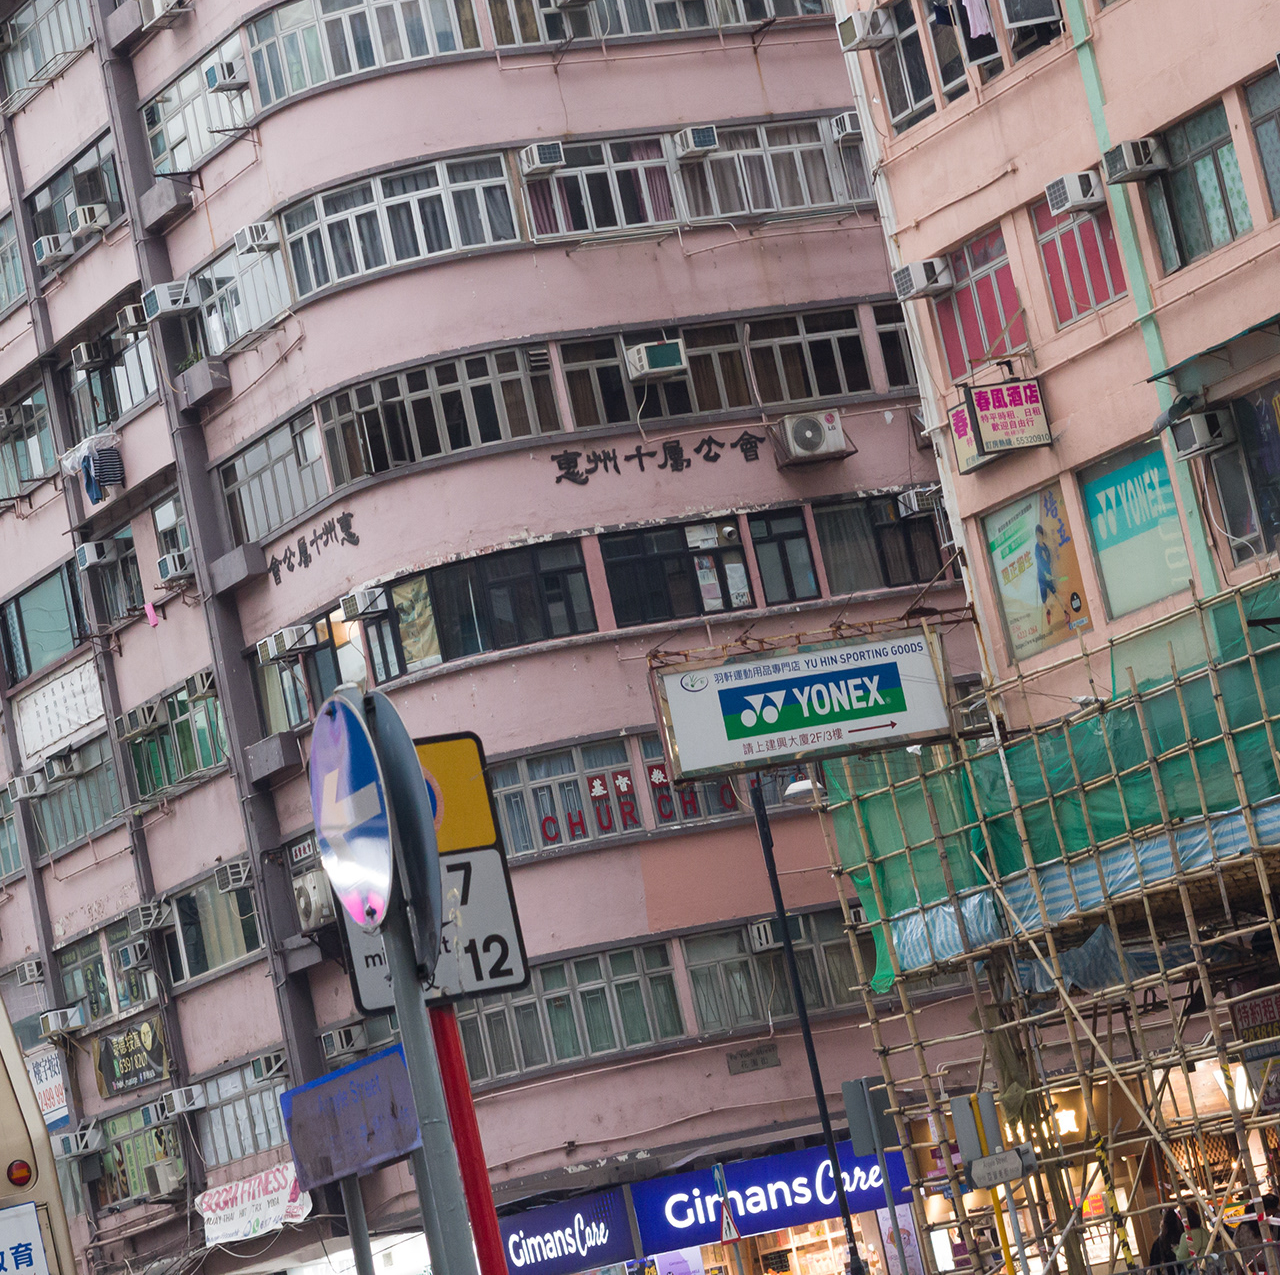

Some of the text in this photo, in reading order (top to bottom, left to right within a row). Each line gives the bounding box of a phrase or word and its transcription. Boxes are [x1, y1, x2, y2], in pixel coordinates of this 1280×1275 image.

[974, 383, 1039, 412] 春風酒店
[550, 430, 766, 486] 惠州十屬公會
[714, 641, 924, 684] 羽軒運動用品專門店 YU HIN SPORTING GOODS
[792, 674, 885, 718] YONEX
[541, 789, 699, 842] CHURCH
[446, 862, 472, 906] 7
[464, 934, 514, 982] 12
[238, 1165, 289, 1204] FITNESS
